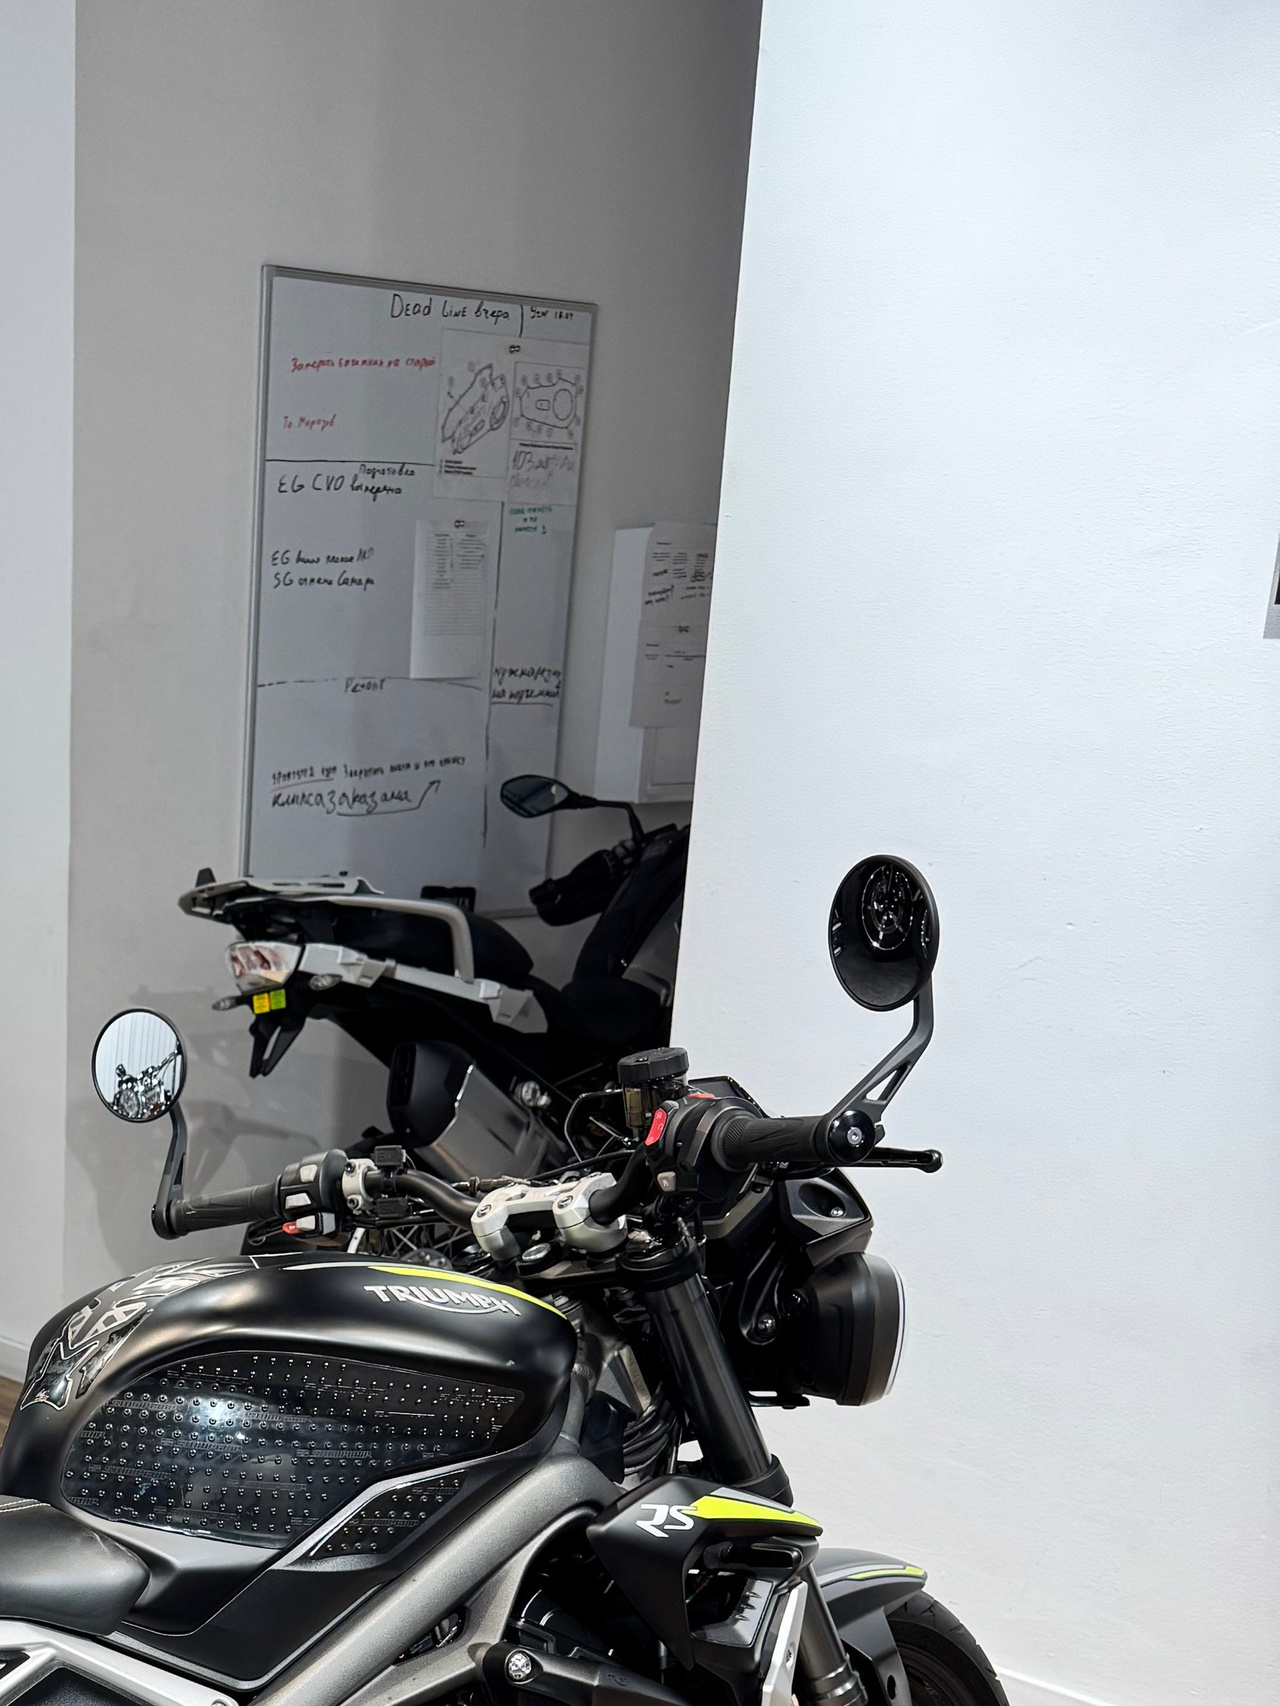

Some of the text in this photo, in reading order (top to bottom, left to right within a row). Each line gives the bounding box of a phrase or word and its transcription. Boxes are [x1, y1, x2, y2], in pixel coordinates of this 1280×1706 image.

[278, 474, 305, 493] EG
[311, 473, 345, 491] CVO
[271, 549, 291, 566] EG
[363, 1285, 522, 1316] TRIUMPH
[635, 1503, 697, 1538] RS
